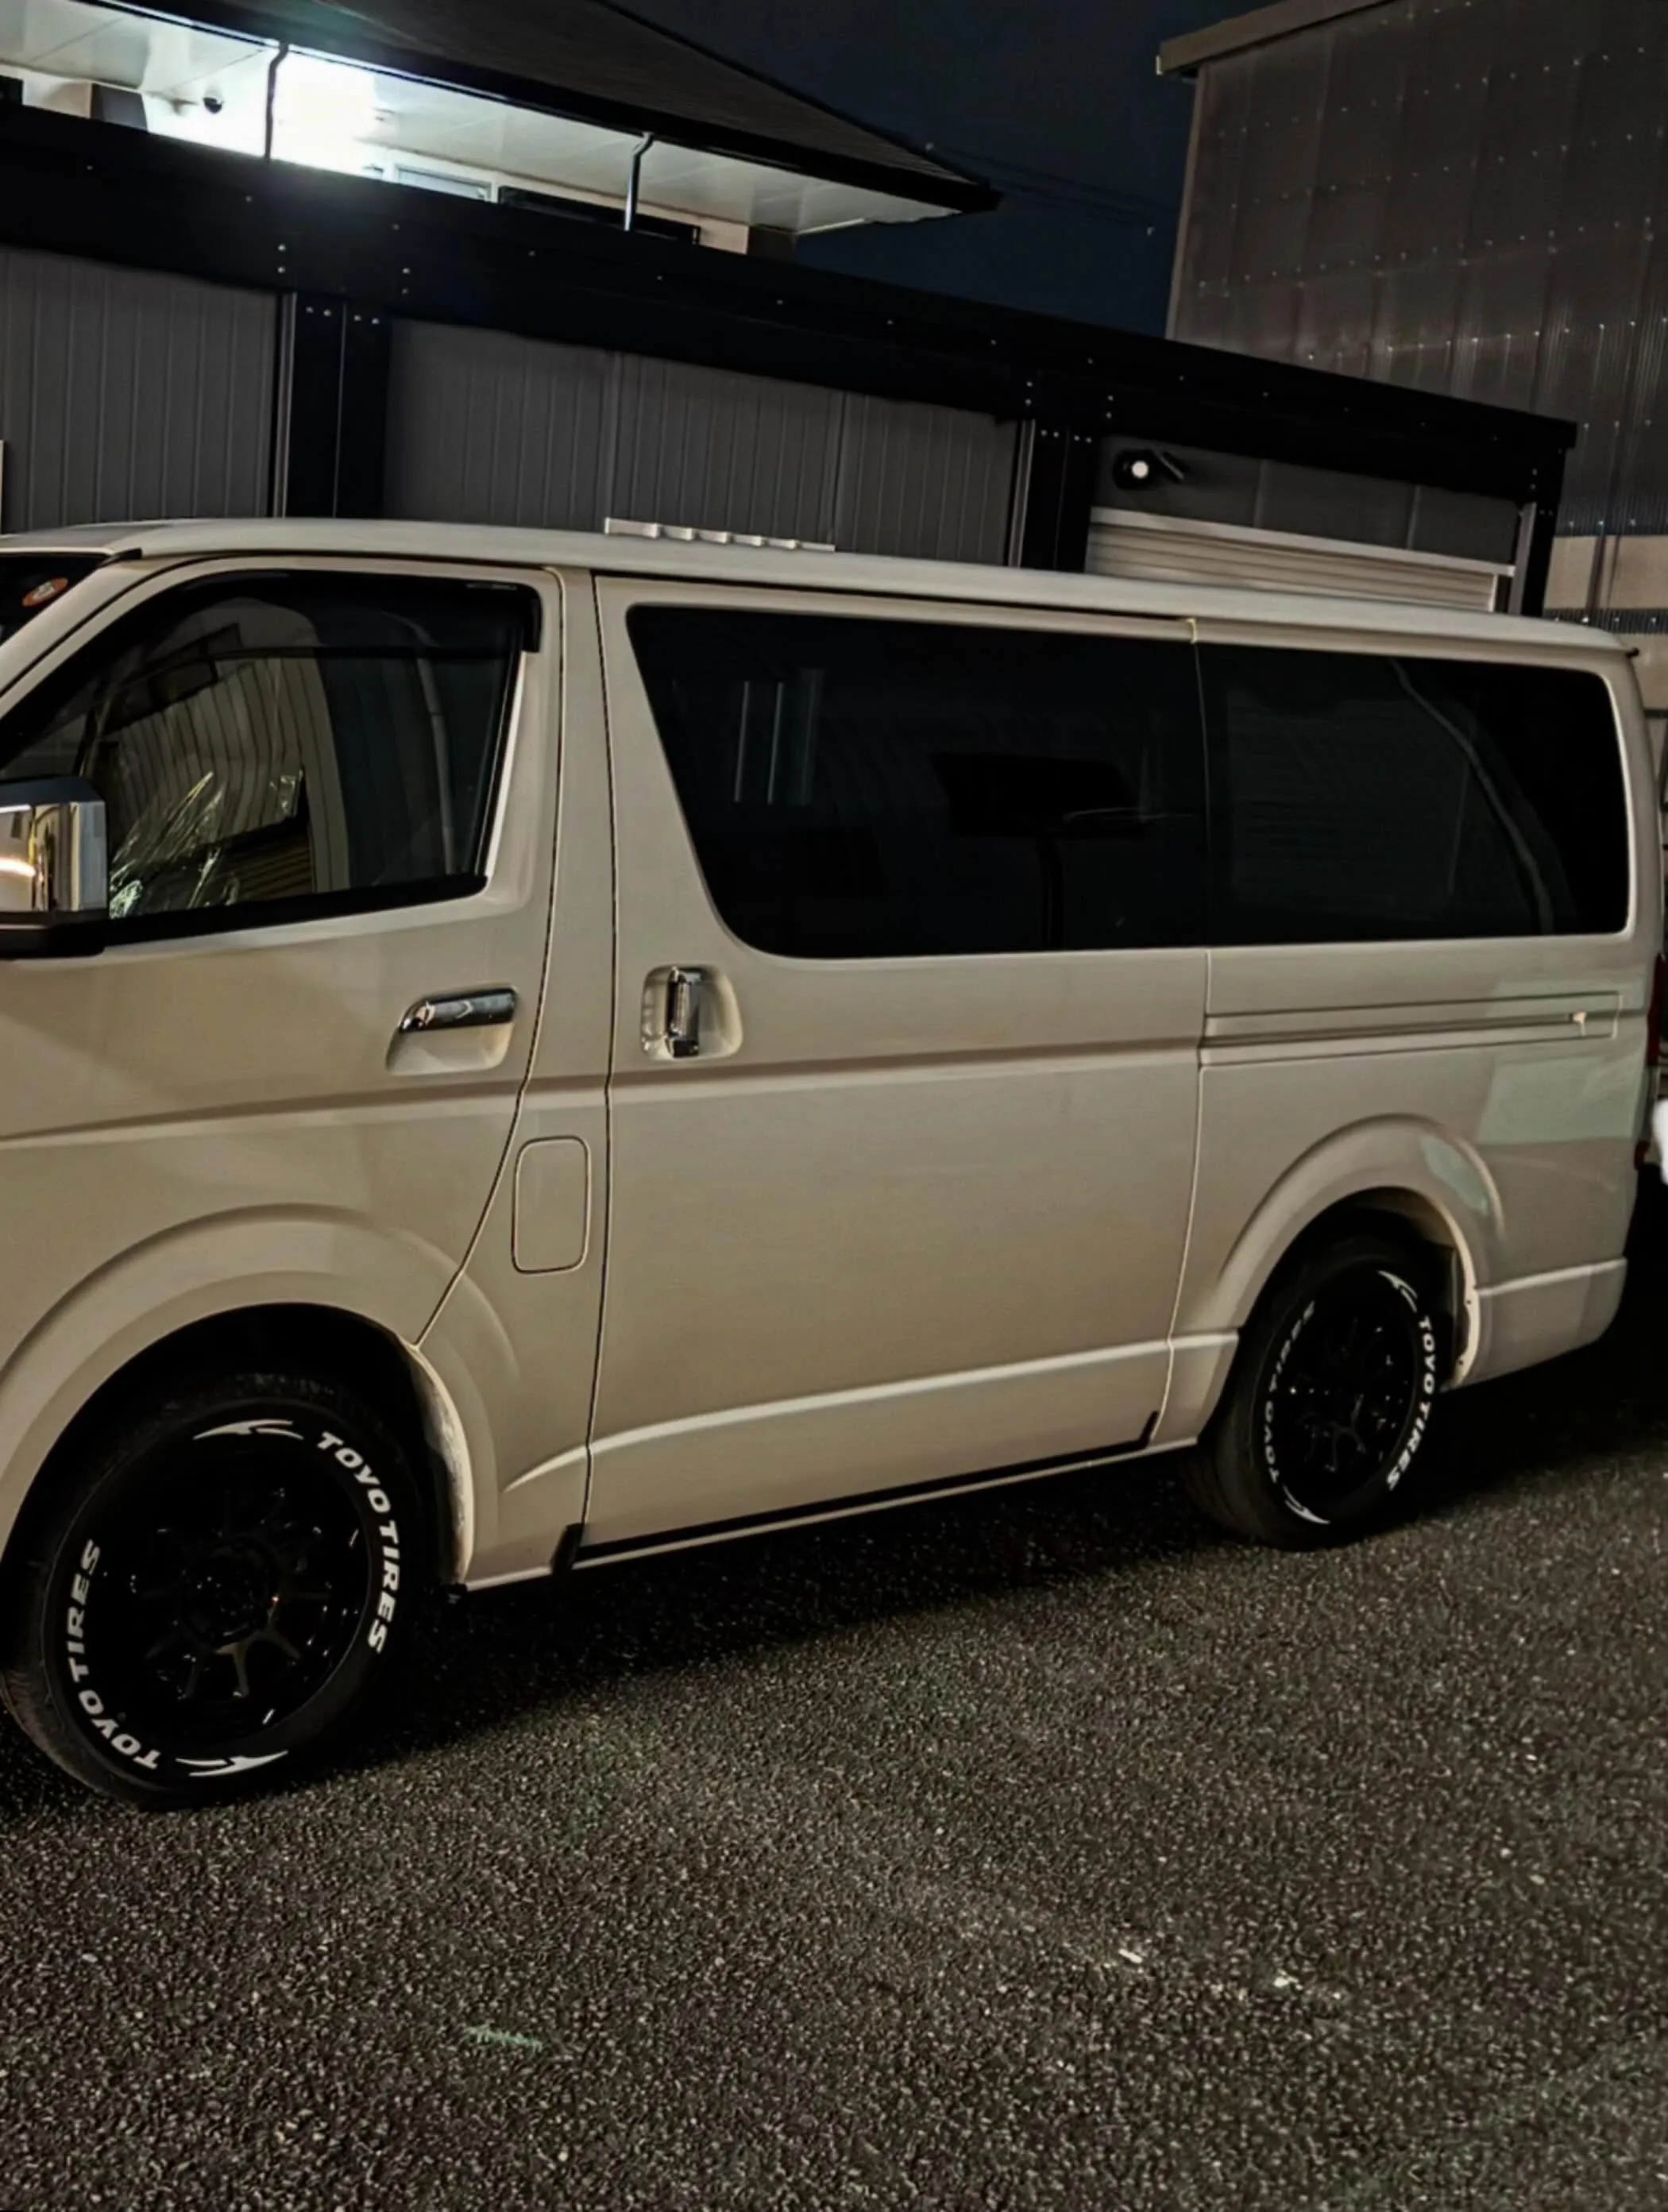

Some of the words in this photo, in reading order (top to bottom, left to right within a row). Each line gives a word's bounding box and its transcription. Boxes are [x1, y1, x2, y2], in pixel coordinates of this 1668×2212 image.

[1419, 1316, 1436, 1396] TOYO
[318, 1431, 391, 1513] TOYO
[368, 1520, 400, 1653] TIRES
[68, 1539, 100, 1682] TIRES
[79, 1690, 160, 1769] TOYO
